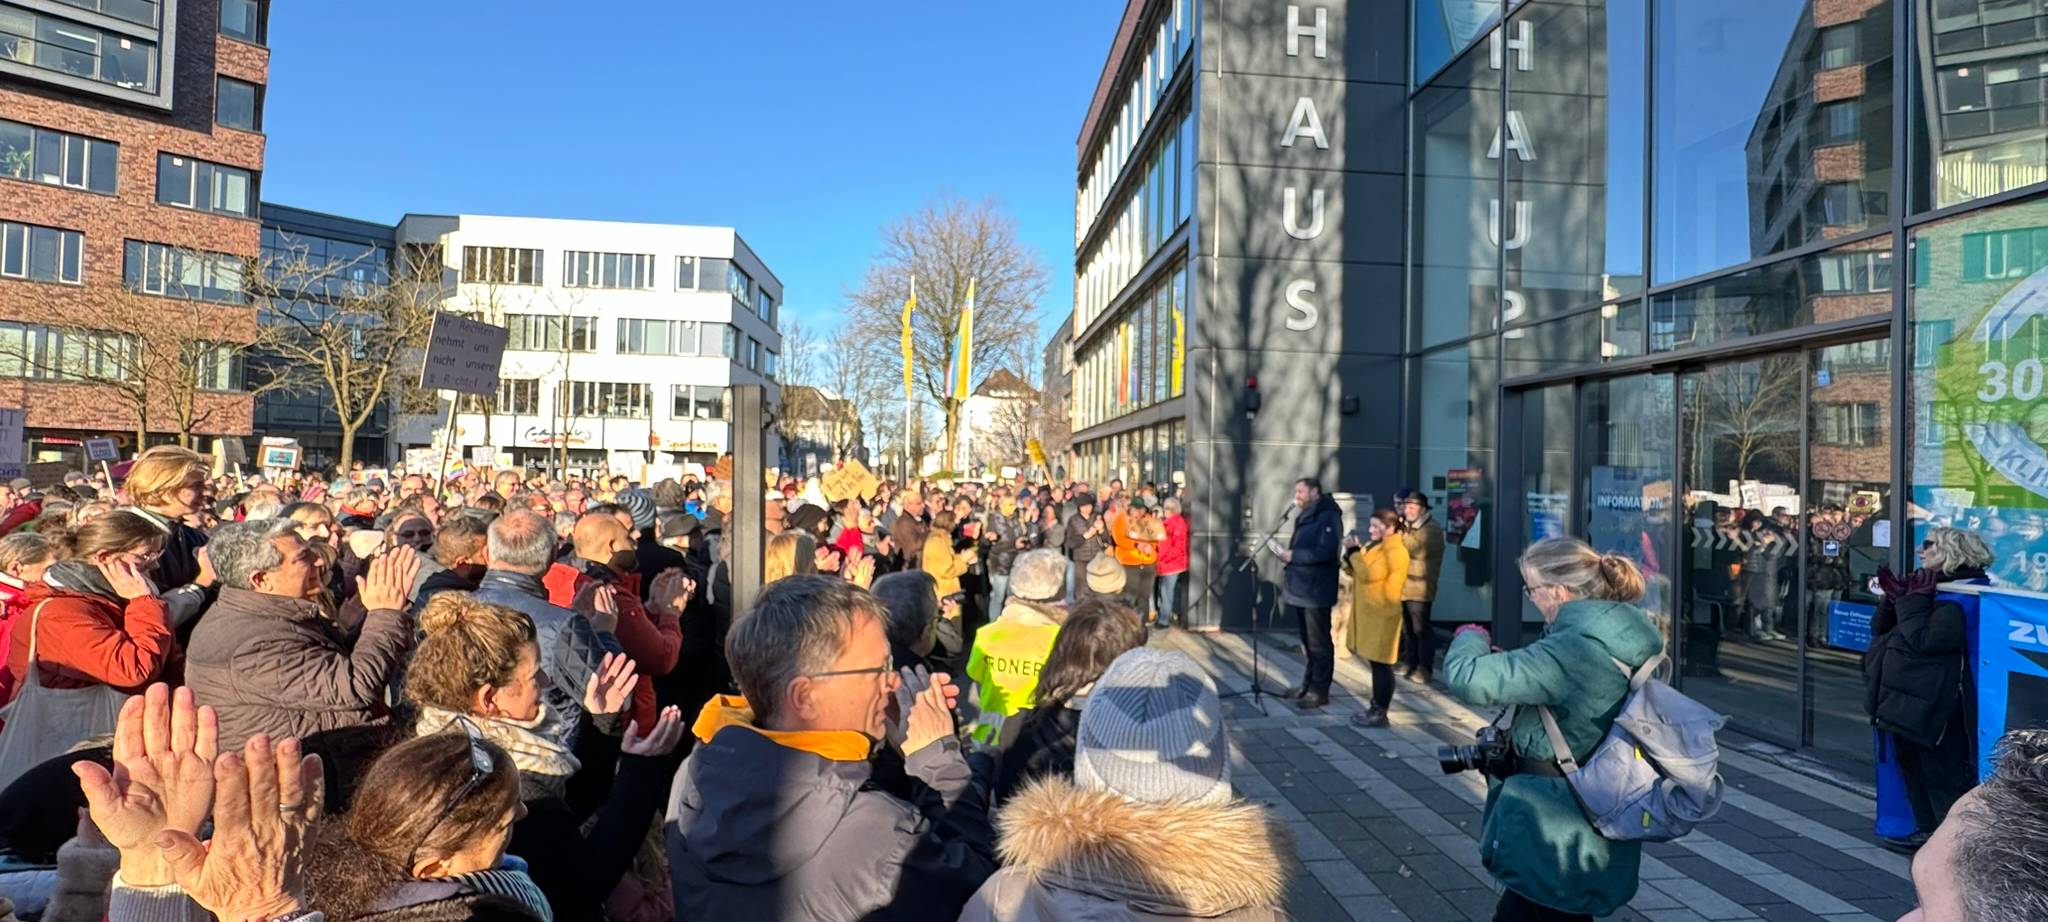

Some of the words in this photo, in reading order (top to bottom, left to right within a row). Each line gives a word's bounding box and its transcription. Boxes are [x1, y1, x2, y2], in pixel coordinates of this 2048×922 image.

[1280, 5, 1329, 331] HAUS
[460, 320, 495, 337] Rechten
[435, 335, 465, 349] nehmt
[474, 343, 489, 354] uns
[433, 354, 456, 368] nicht
[466, 360, 495, 372] unsere
[1977, 360, 2044, 402] 30
[1597, 495, 1664, 510] INFORMATION
